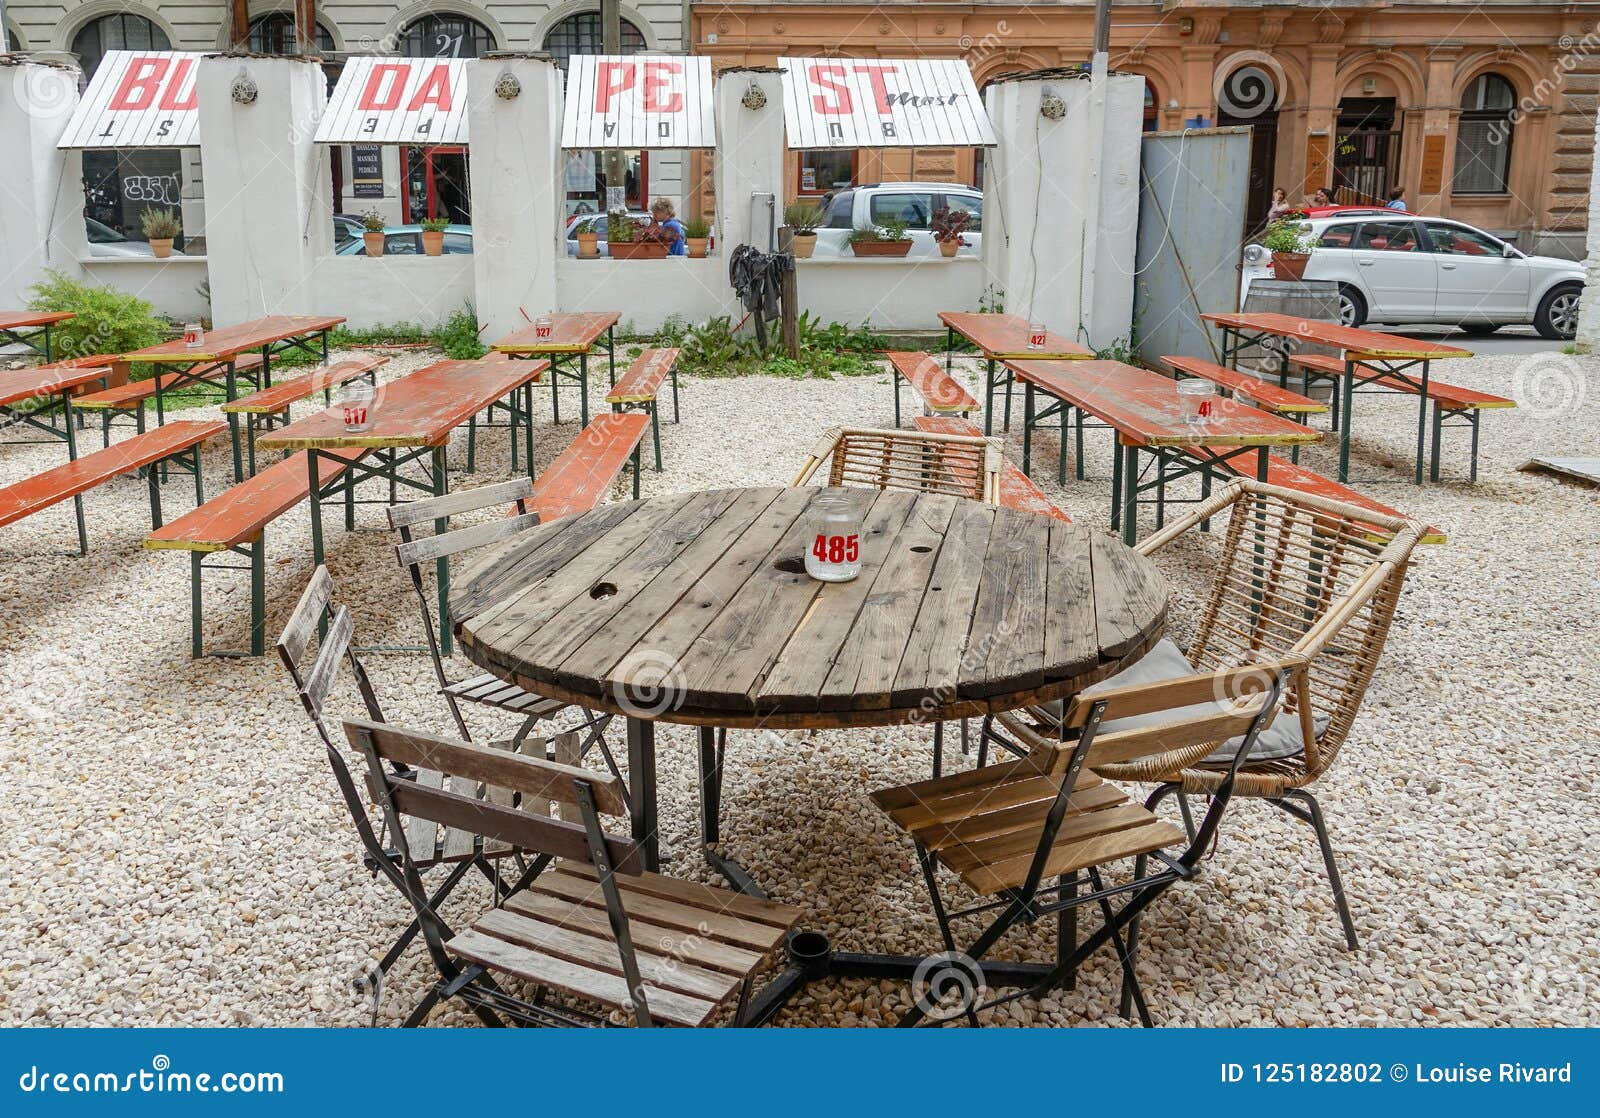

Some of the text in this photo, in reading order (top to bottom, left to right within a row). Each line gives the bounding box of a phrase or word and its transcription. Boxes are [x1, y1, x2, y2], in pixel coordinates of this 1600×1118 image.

[434, 34, 464, 58] 21
[107, 57, 199, 111] BU
[357, 63, 452, 112] DA
[595, 61, 683, 113] PE
[808, 65, 899, 115] ST
[536, 327, 551, 338] 327
[344, 407, 367, 425] 317
[813, 533, 859, 564] 485
